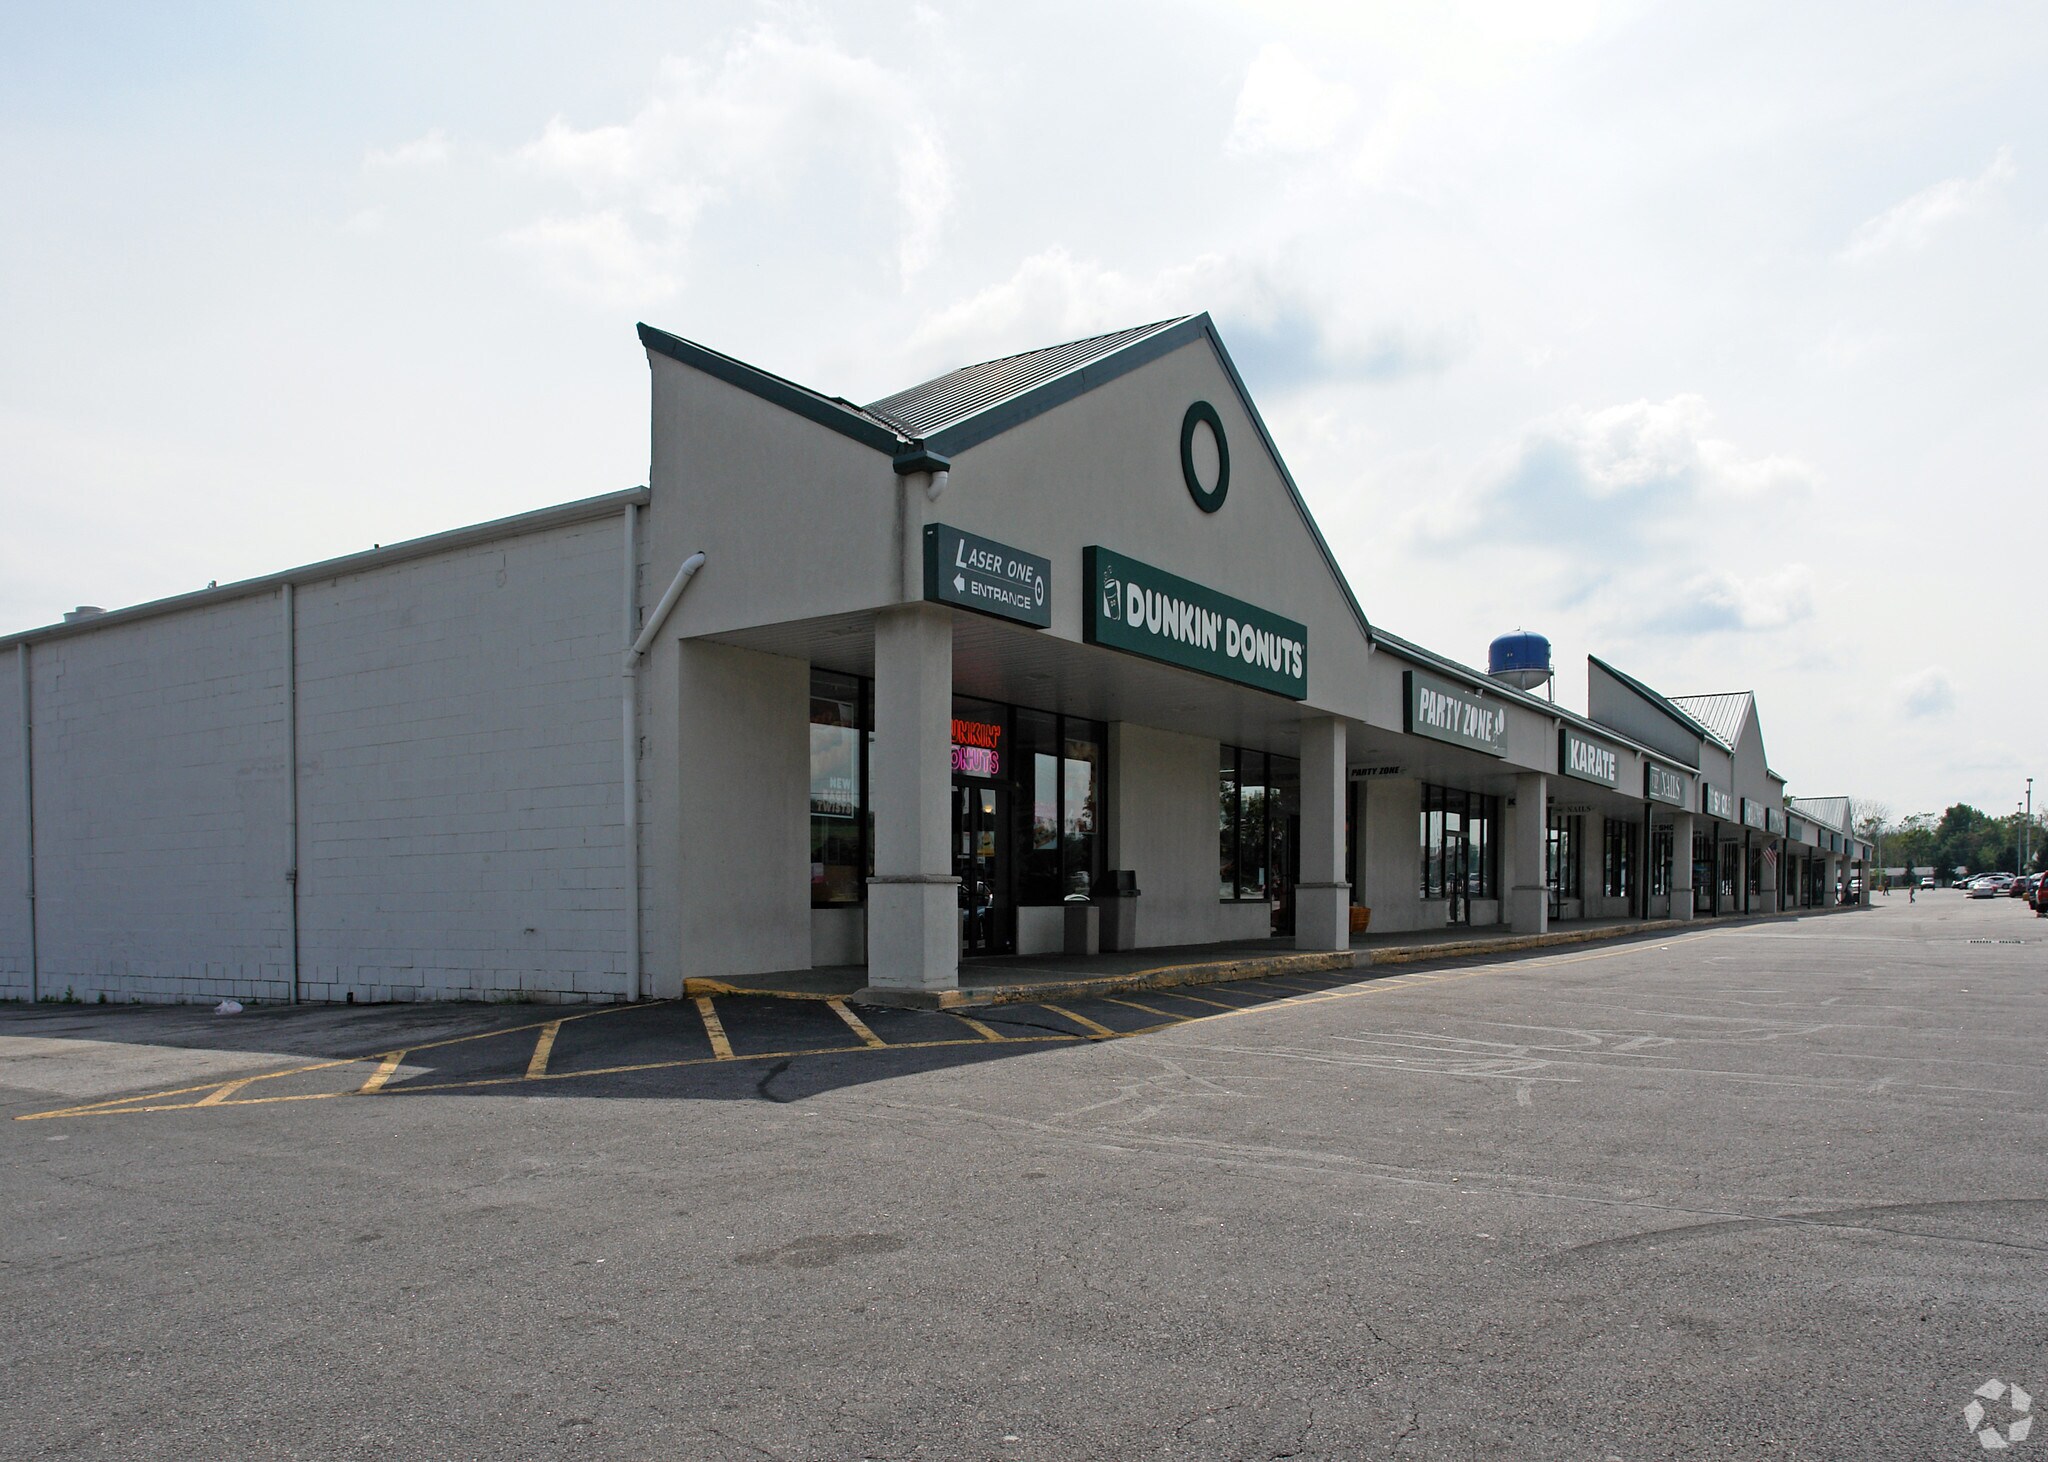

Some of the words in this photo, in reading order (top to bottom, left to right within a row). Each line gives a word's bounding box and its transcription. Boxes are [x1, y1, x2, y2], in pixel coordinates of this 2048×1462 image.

[955, 538, 1002, 573] LASER
[1007, 560, 1034, 583] ONE
[971, 580, 1031, 609] ENTRANCE
[1127, 582, 1222, 652] DUNKIN'
[1226, 617, 1303, 679] DONUTS
[1418, 687, 1462, 732] PARTY
[1463, 703, 1493, 742] ZONE
[951, 719, 1001, 748] UNKIN'
[951, 745, 999, 774] ONUTS
[1351, 767, 1378, 777] PARTY
[1379, 766, 1400, 775] ZONE
[1571, 738, 1615, 781] KARATE
[830, 776, 851, 789] NEW
[1661, 771, 1680, 800] NAILS
